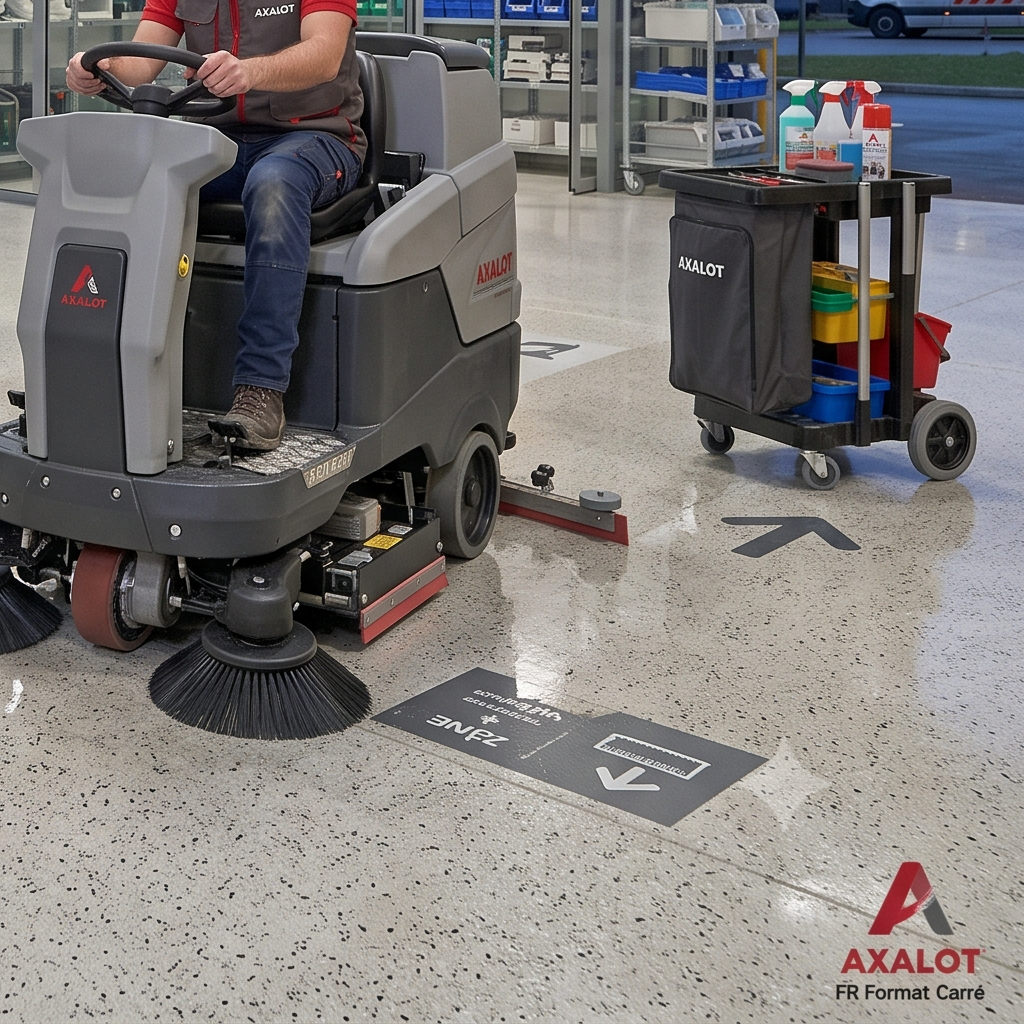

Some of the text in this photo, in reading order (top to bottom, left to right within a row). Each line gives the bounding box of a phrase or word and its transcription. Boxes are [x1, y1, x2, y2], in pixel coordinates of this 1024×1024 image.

[254, 4, 295, 17] AXALOT
[477, 251, 513, 285] AXALOT
[678, 255, 725, 278] AXALOT
[61, 294, 108, 309] AXALOT
